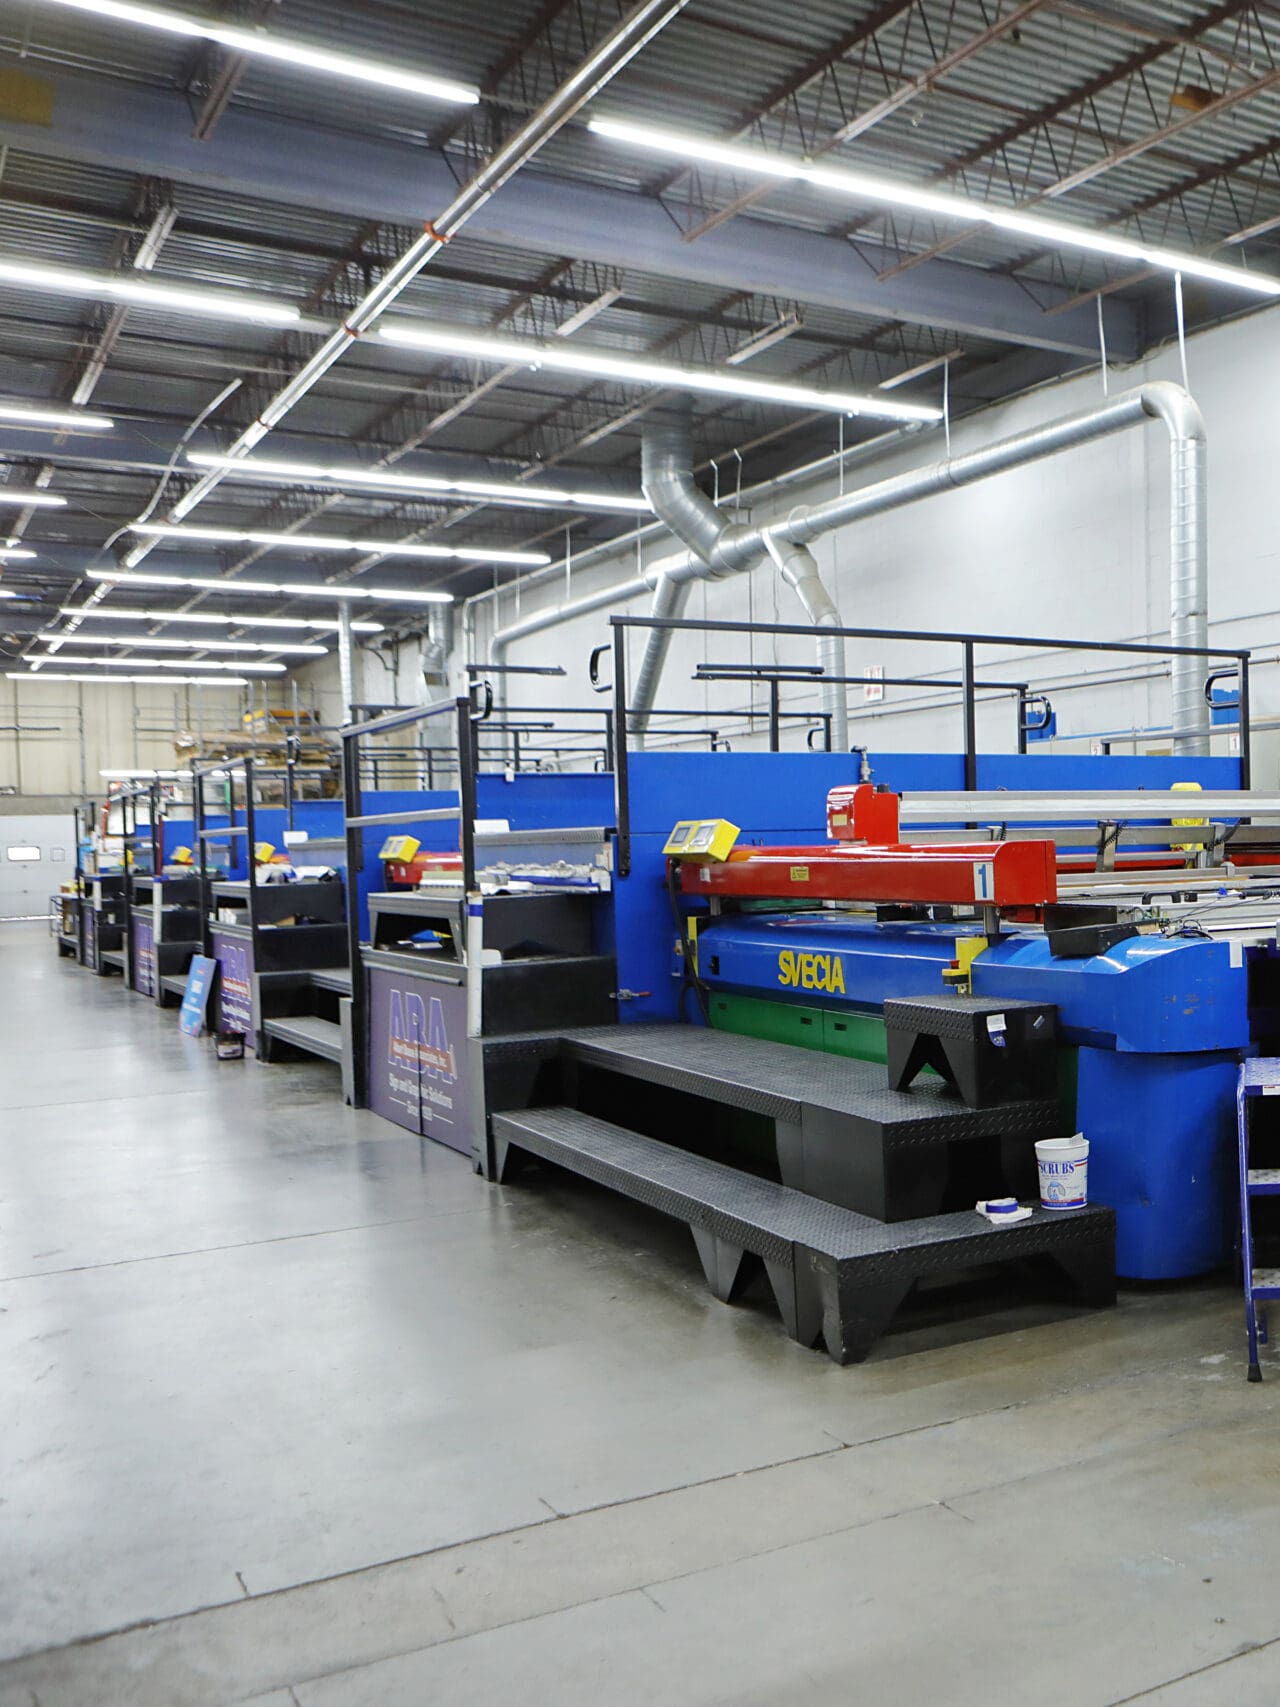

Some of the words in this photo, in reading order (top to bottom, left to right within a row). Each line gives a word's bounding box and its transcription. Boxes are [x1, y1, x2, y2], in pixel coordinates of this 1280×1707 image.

[978, 863, 988, 899] 1
[778, 949, 846, 995] SVECIA
[1039, 1160, 1075, 1175] SCRUBS
